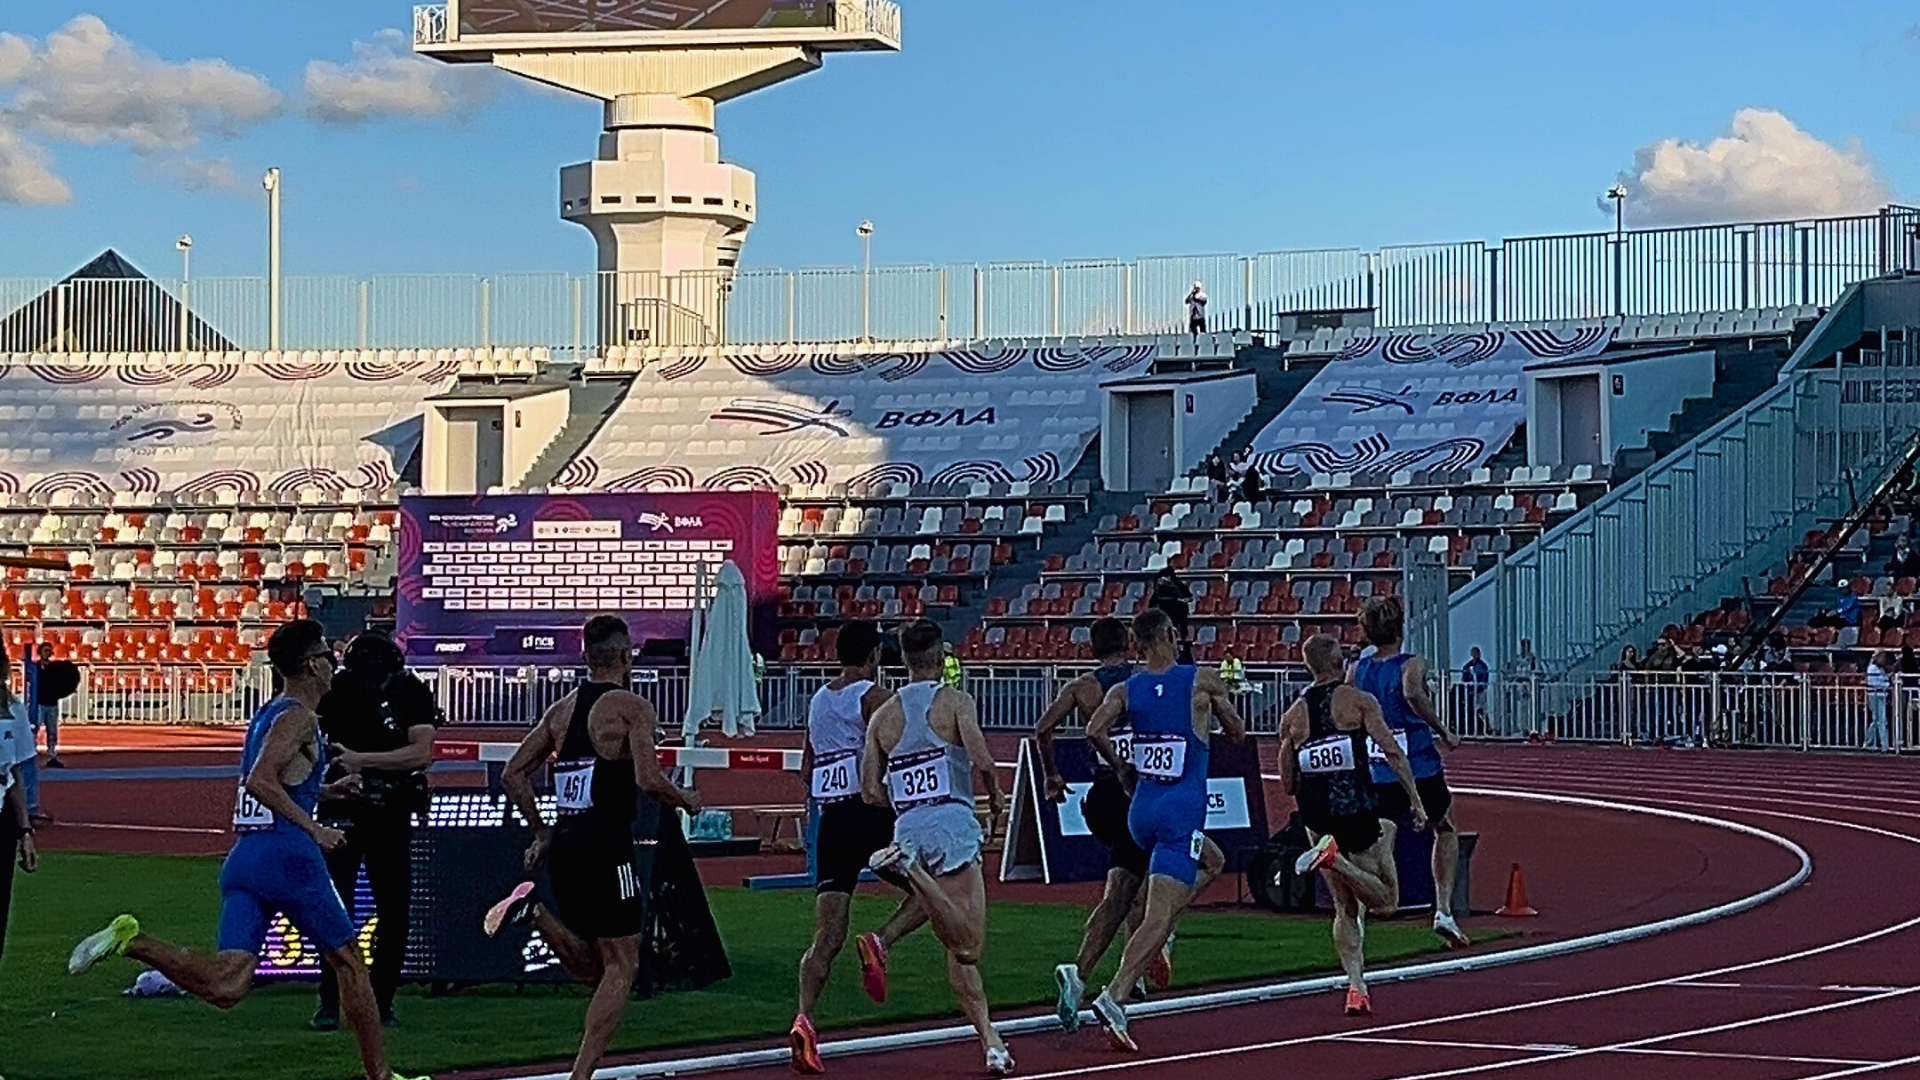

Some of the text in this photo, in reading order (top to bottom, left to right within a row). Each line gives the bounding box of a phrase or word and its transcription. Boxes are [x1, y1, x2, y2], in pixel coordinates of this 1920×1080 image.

[1432, 388, 1517, 405] ВФЛА
[874, 406, 995, 429] ВФЛА
[1143, 746, 1174, 771] 283
[1309, 746, 1343, 770] 586
[563, 774, 587, 803] 461
[821, 765, 848, 793] 240
[902, 765, 939, 797] 325
